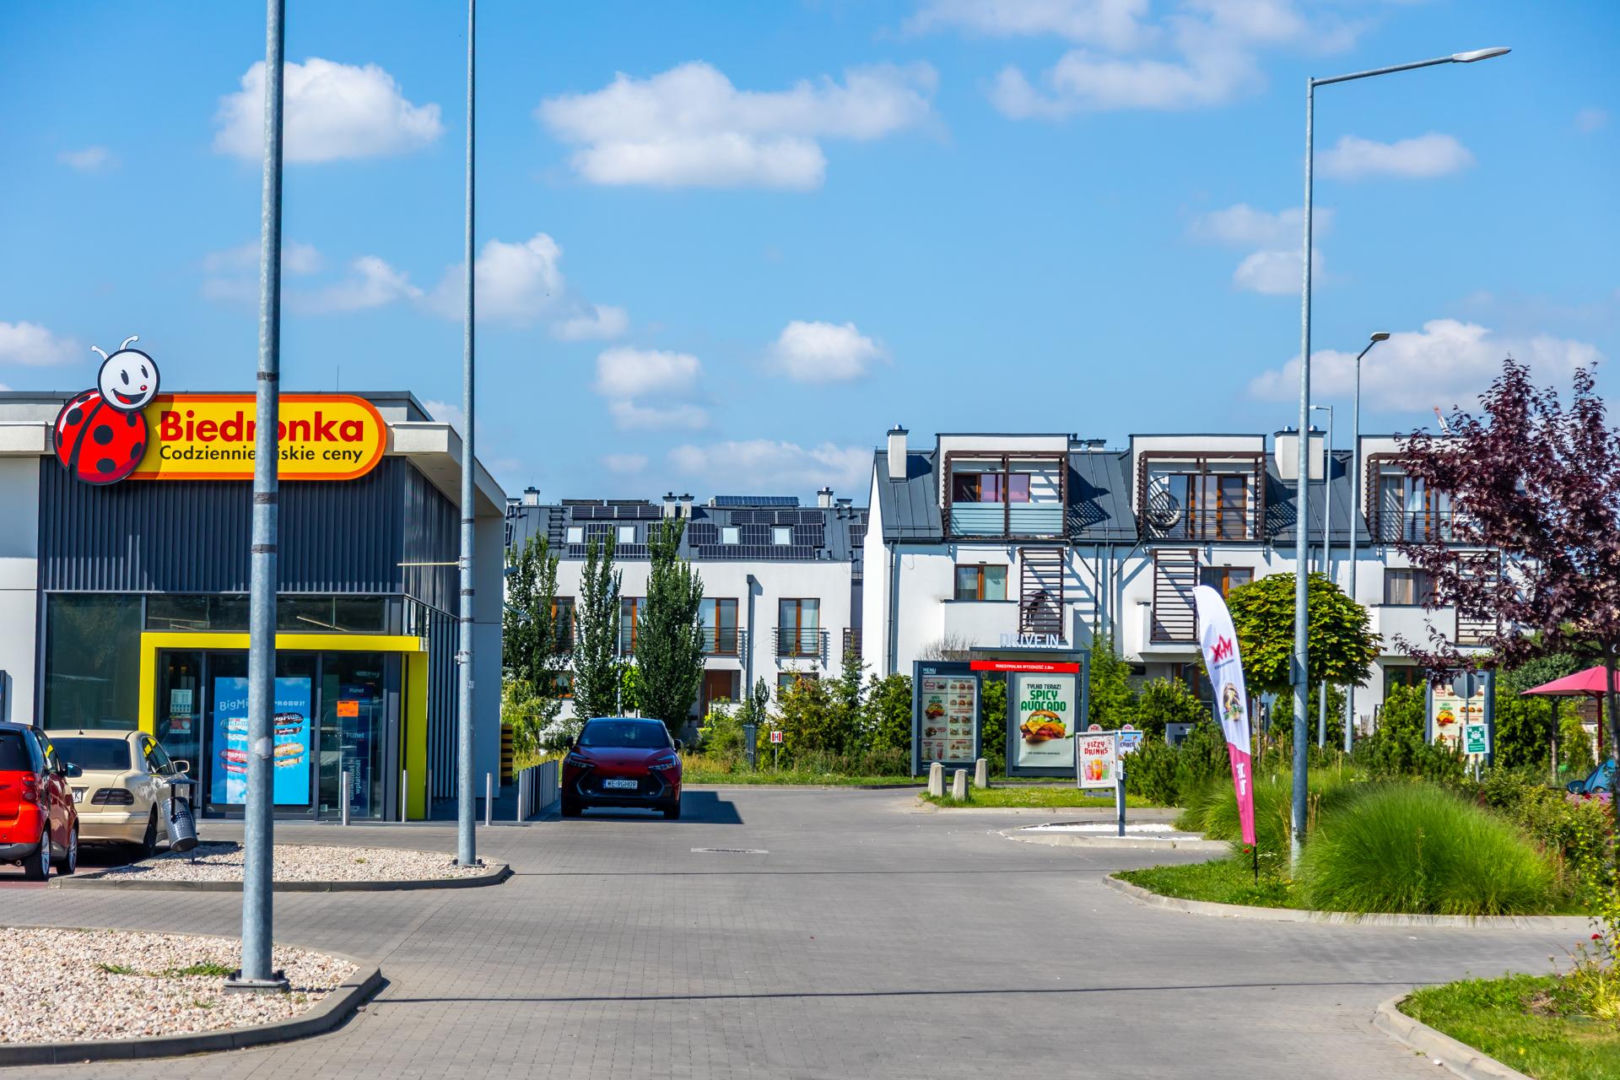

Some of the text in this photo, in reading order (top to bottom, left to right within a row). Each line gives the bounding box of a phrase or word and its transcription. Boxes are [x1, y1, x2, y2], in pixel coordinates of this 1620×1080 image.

[159, 445, 256, 460] Codziennie
[323, 449, 363, 463] ceny
[1000, 633, 1059, 646] DRIVE IN
[1030, 690, 1058, 700] SPICY
[1020, 700, 1067, 711] AVOCADO
[1087, 740, 1105, 748] FIZZY
[1084, 747, 1109, 755] DRINKS
